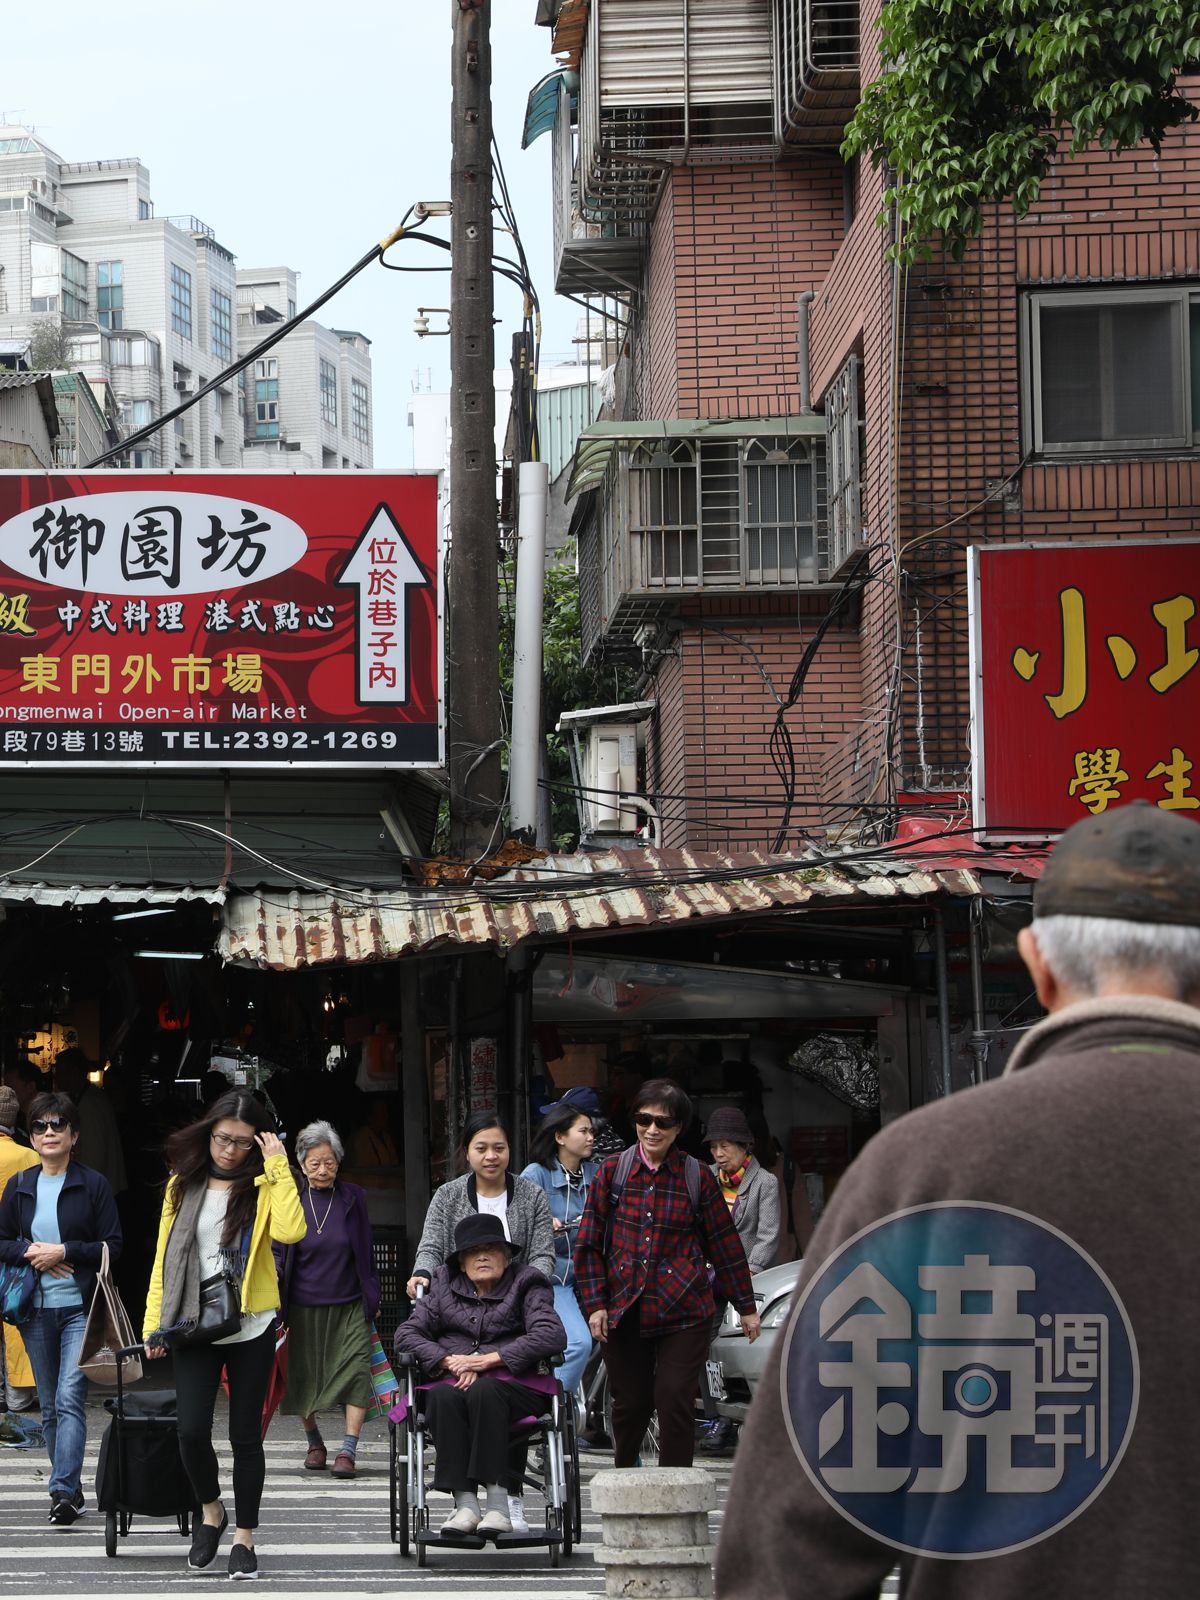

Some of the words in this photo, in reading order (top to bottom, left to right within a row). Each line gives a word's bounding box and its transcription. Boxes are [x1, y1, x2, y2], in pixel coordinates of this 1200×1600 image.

[28, 505, 274, 589] 御園坊
[56, 599, 186, 636] 中式料理
[205, 599, 337, 634] 港式點心
[367, 537, 398, 689] 位於巷子內
[19, 653, 263, 695] 東門外市場
[119, 702, 219, 721] Open-air
[231, 702, 308, 720] Market
[161, 731, 398, 749] TEL:2392-1269
[1068, 747, 1200, 815] 學生
